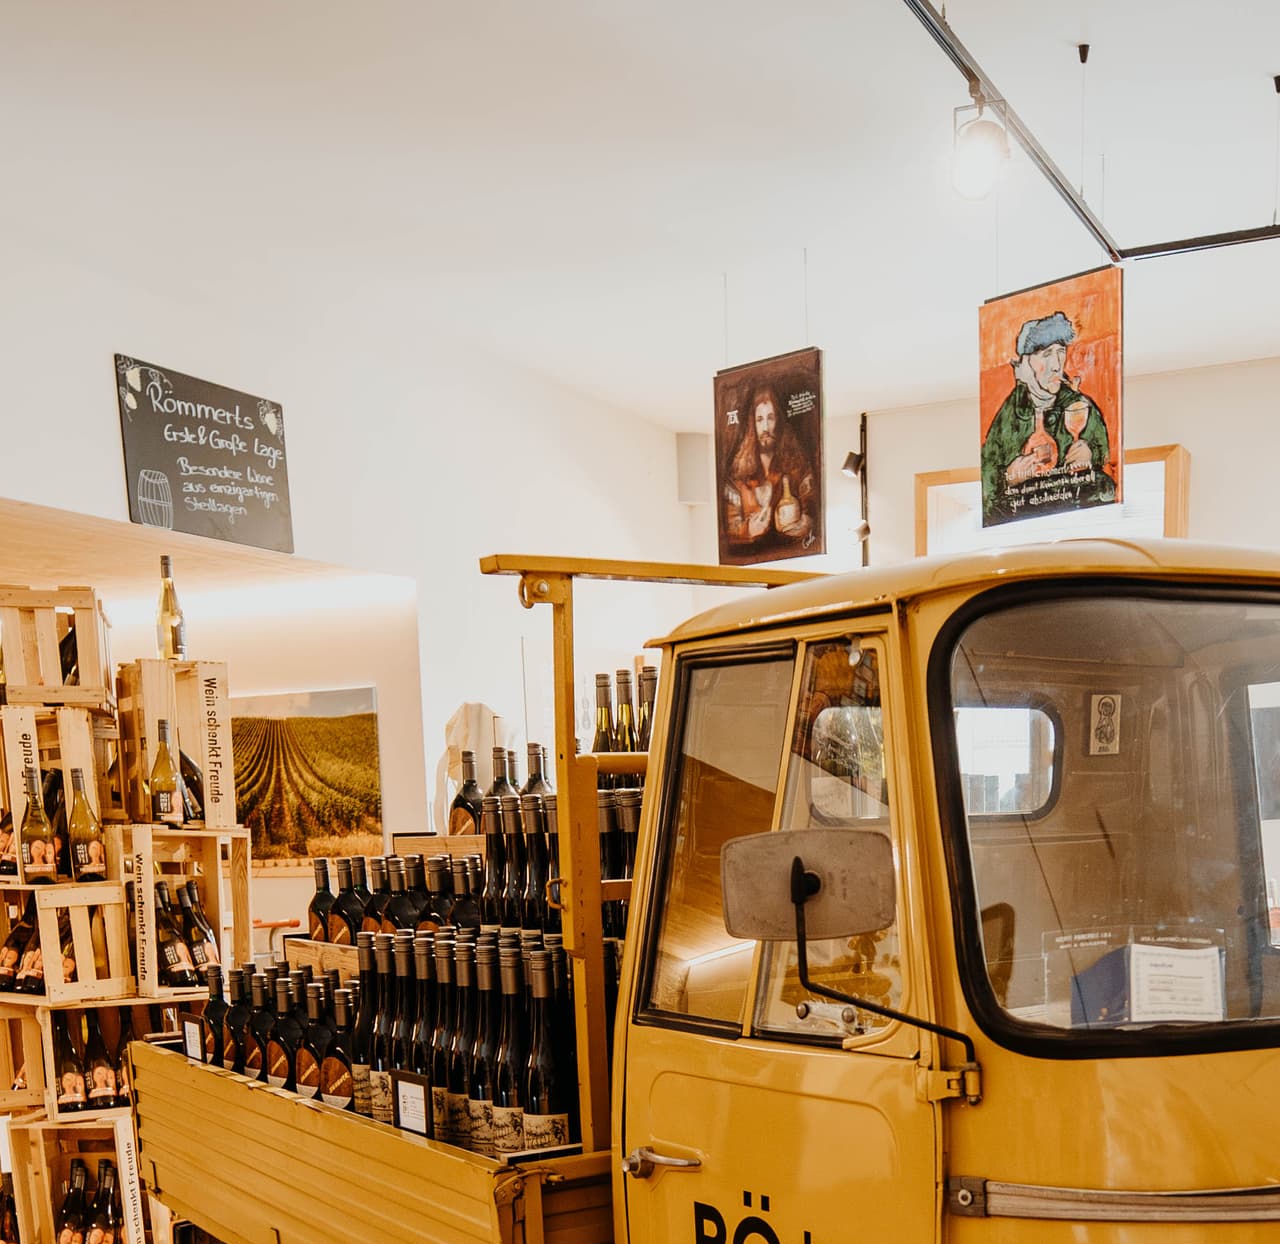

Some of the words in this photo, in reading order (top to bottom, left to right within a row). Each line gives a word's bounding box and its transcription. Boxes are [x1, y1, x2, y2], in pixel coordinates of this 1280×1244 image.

[146, 382, 255, 430] Römmerts
[209, 430, 248, 456] Große
[177, 457, 242, 480] Besondere
[182, 482, 206, 494] aus
[210, 482, 279, 508] einzigartigen
[184, 497, 247, 524] Steillagen
[1010, 497, 1025, 513] gut
[203, 678, 218, 707] Wein
[206, 710, 222, 759] schenkt
[209, 762, 224, 804] Freude
[135, 852, 144, 884] Wein
[136, 888, 146, 936] schenkt
[139, 939, 148, 982] Freude
[126, 1142, 136, 1186] Freude
[129, 1187, 141, 1235] schenkt
